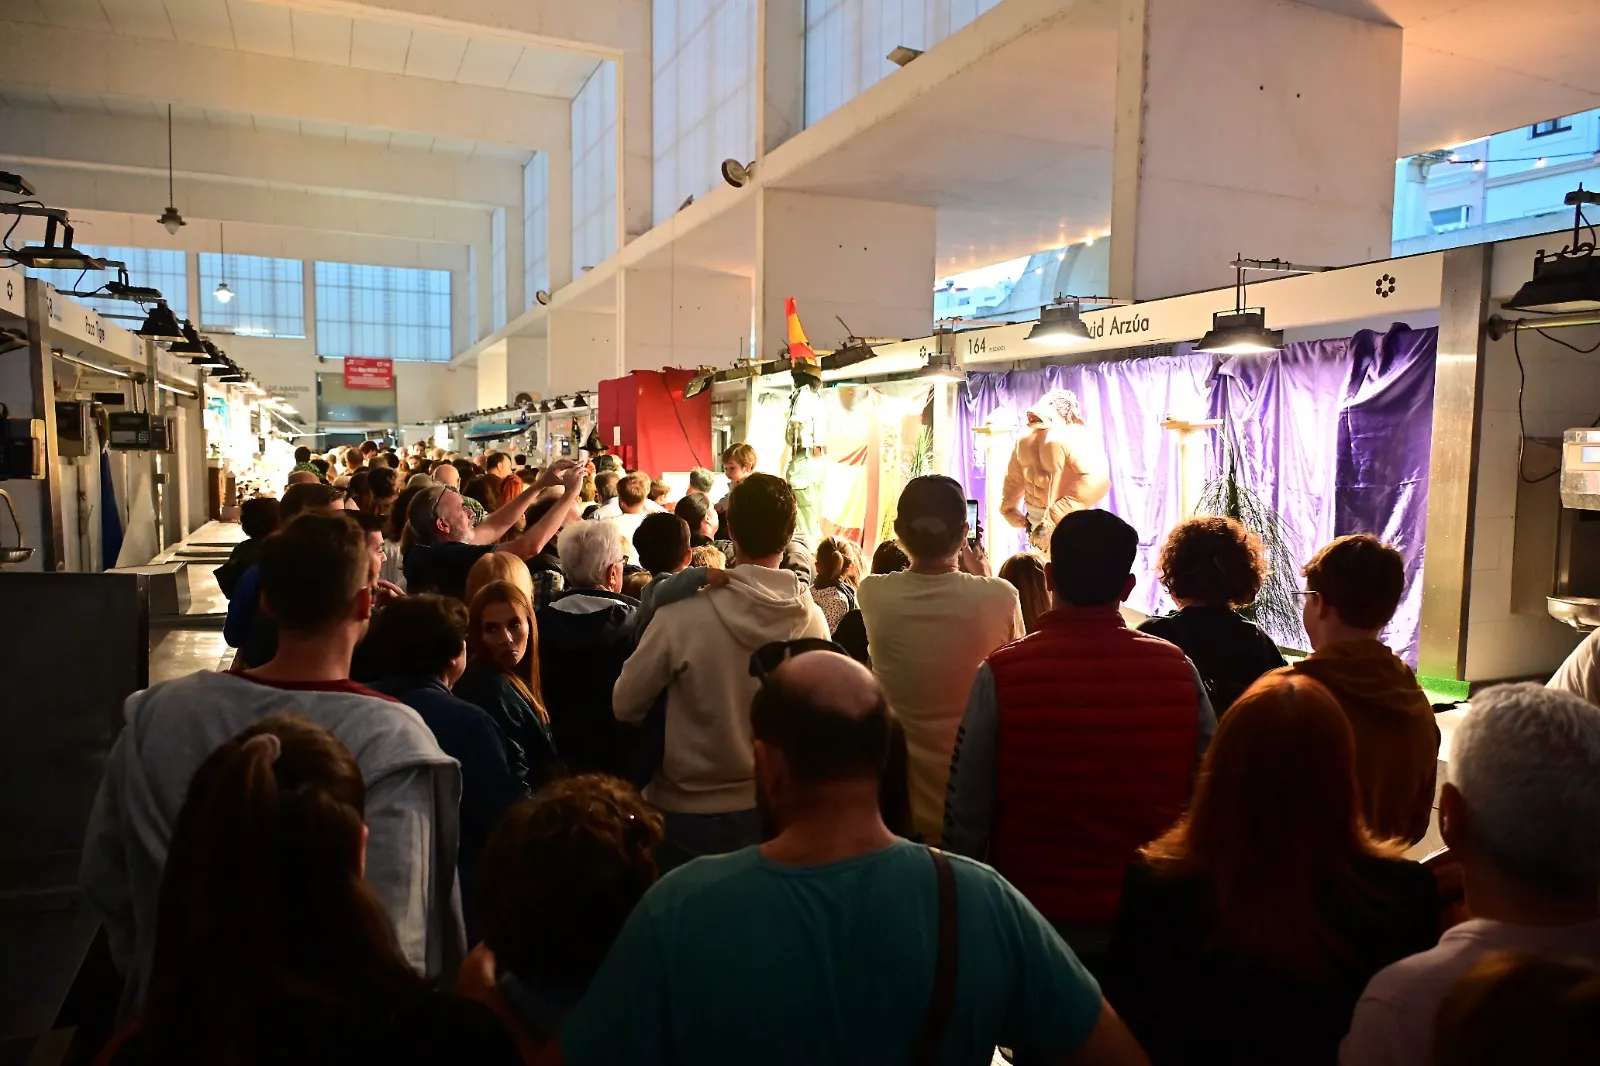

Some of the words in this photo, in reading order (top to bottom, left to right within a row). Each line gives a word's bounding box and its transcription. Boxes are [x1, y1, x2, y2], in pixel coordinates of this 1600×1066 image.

[85, 315, 95, 336] Paco
[95, 320, 105, 344] Tigre
[1109, 313, 1150, 336] Arzúa
[968, 336, 986, 355] 164
